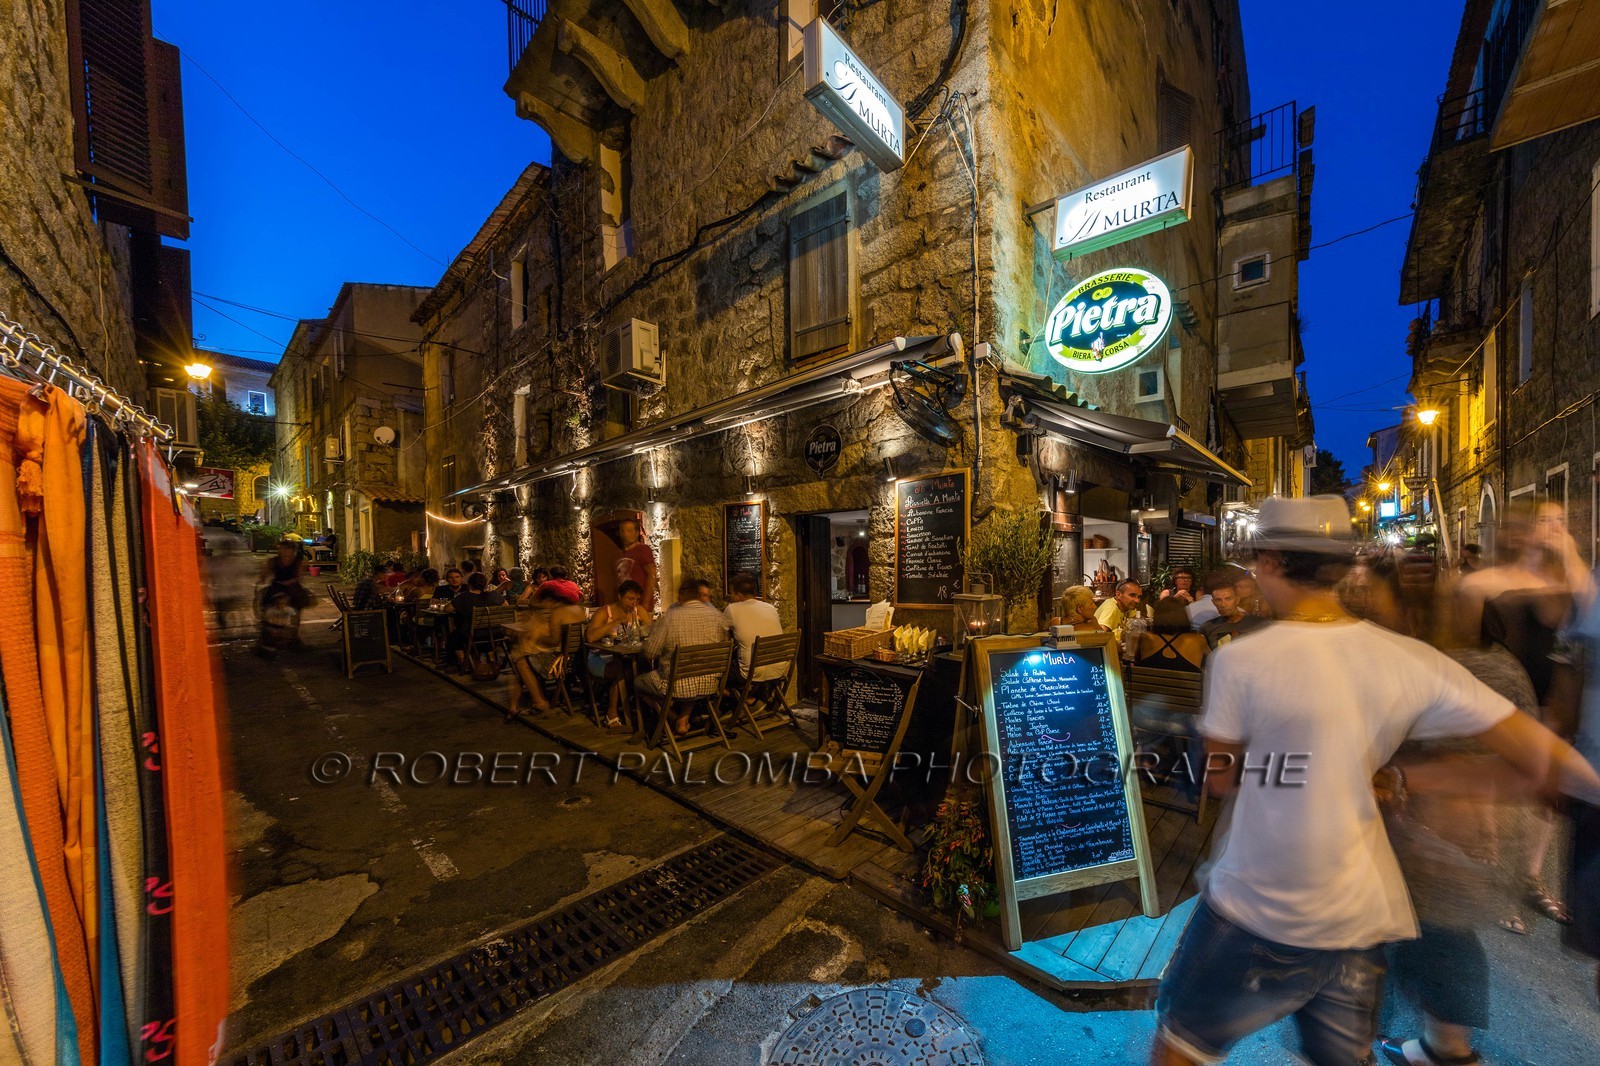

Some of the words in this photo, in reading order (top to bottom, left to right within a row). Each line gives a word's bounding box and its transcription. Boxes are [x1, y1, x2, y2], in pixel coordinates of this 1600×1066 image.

[844, 52, 888, 108] Restaurant
[859, 100, 902, 156] MURTA
[1085, 170, 1152, 204] Restaurant
[1103, 190, 1180, 231] MURTA
[1077, 273, 1134, 294] BRASSERIE
[1050, 294, 1160, 345] Pietra
[1072, 350, 1092, 360] BIERA
[1104, 340, 1130, 357] CORSA
[809, 441, 836, 455] Pietra
